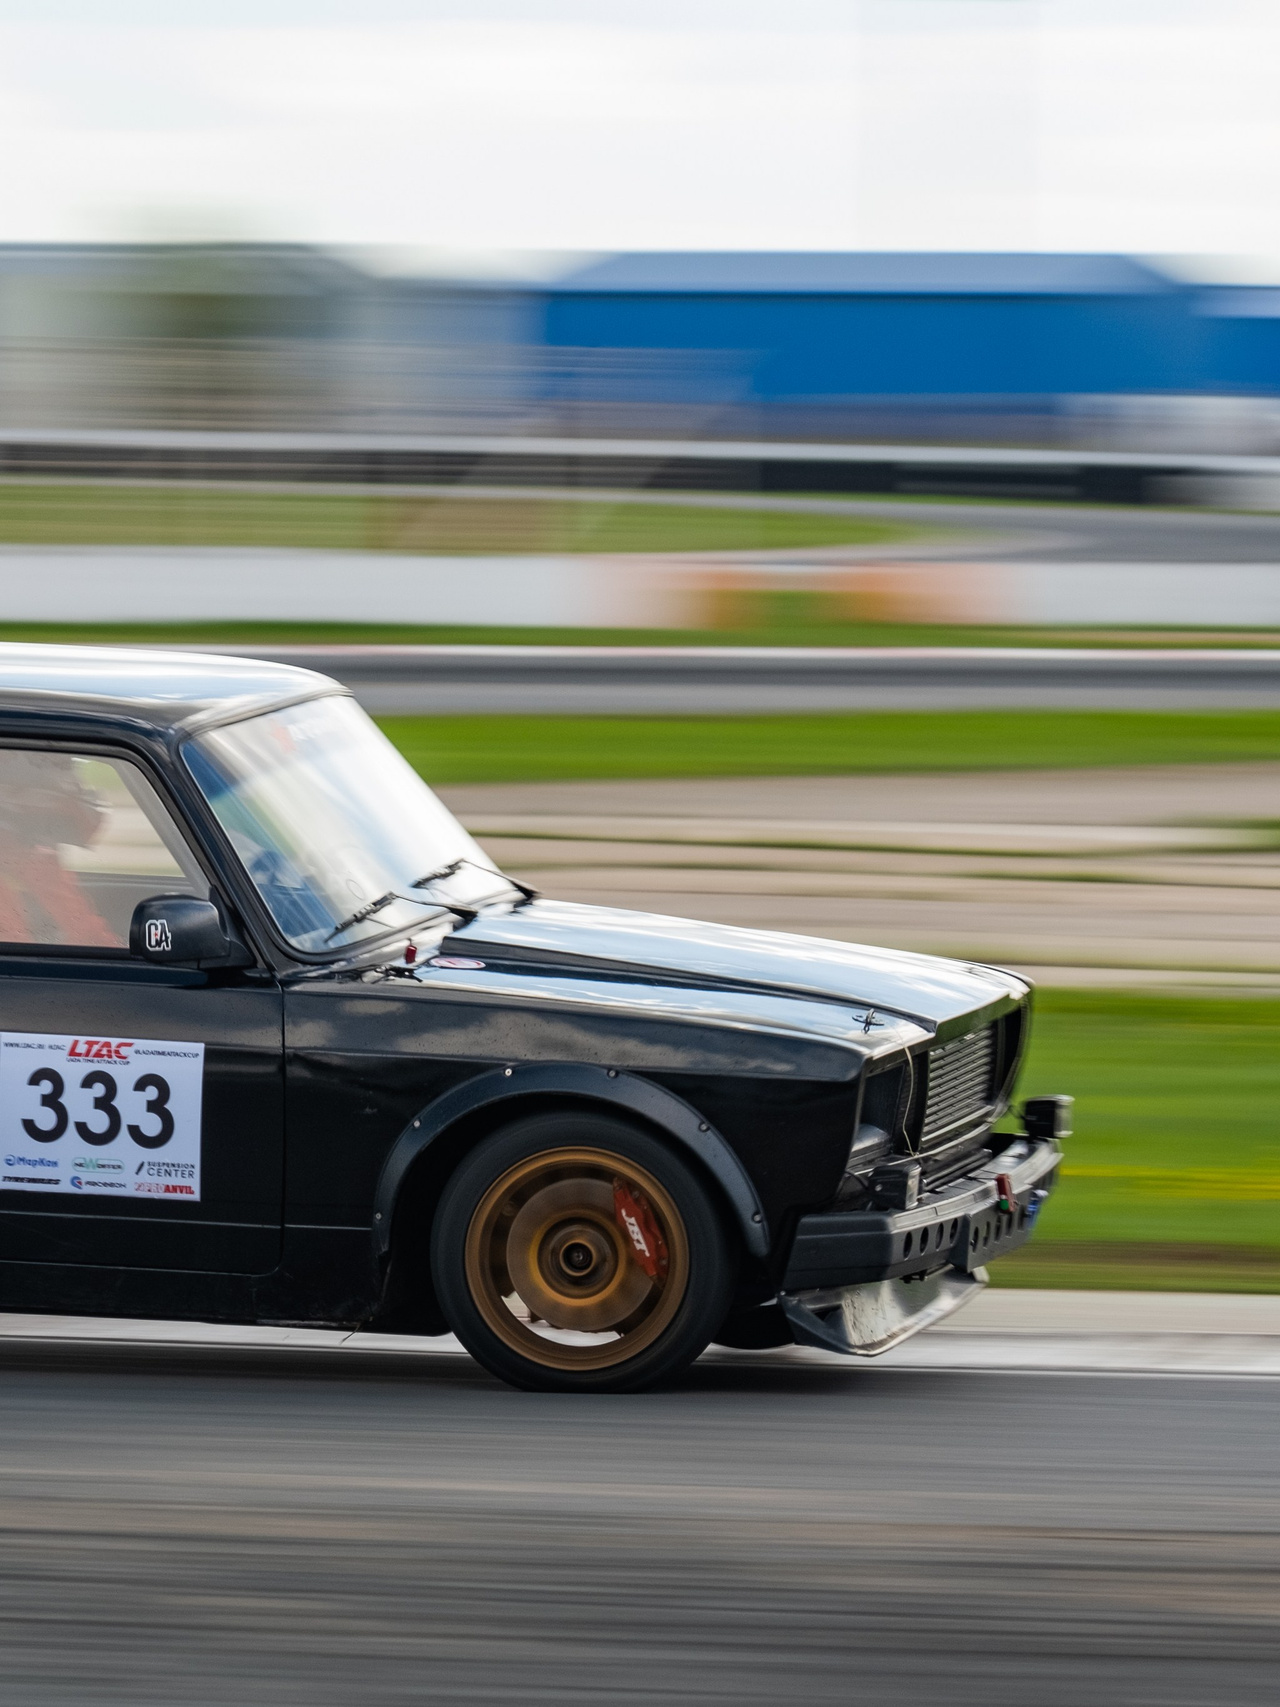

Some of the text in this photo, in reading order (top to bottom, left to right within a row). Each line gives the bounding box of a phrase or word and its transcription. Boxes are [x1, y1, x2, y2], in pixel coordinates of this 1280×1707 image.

[67, 1039, 134, 1059] LTAC
[21, 1067, 175, 1149] 333
[147, 1161, 195, 1169] SUSPENSION
[147, 1167, 195, 1179] CENTER
